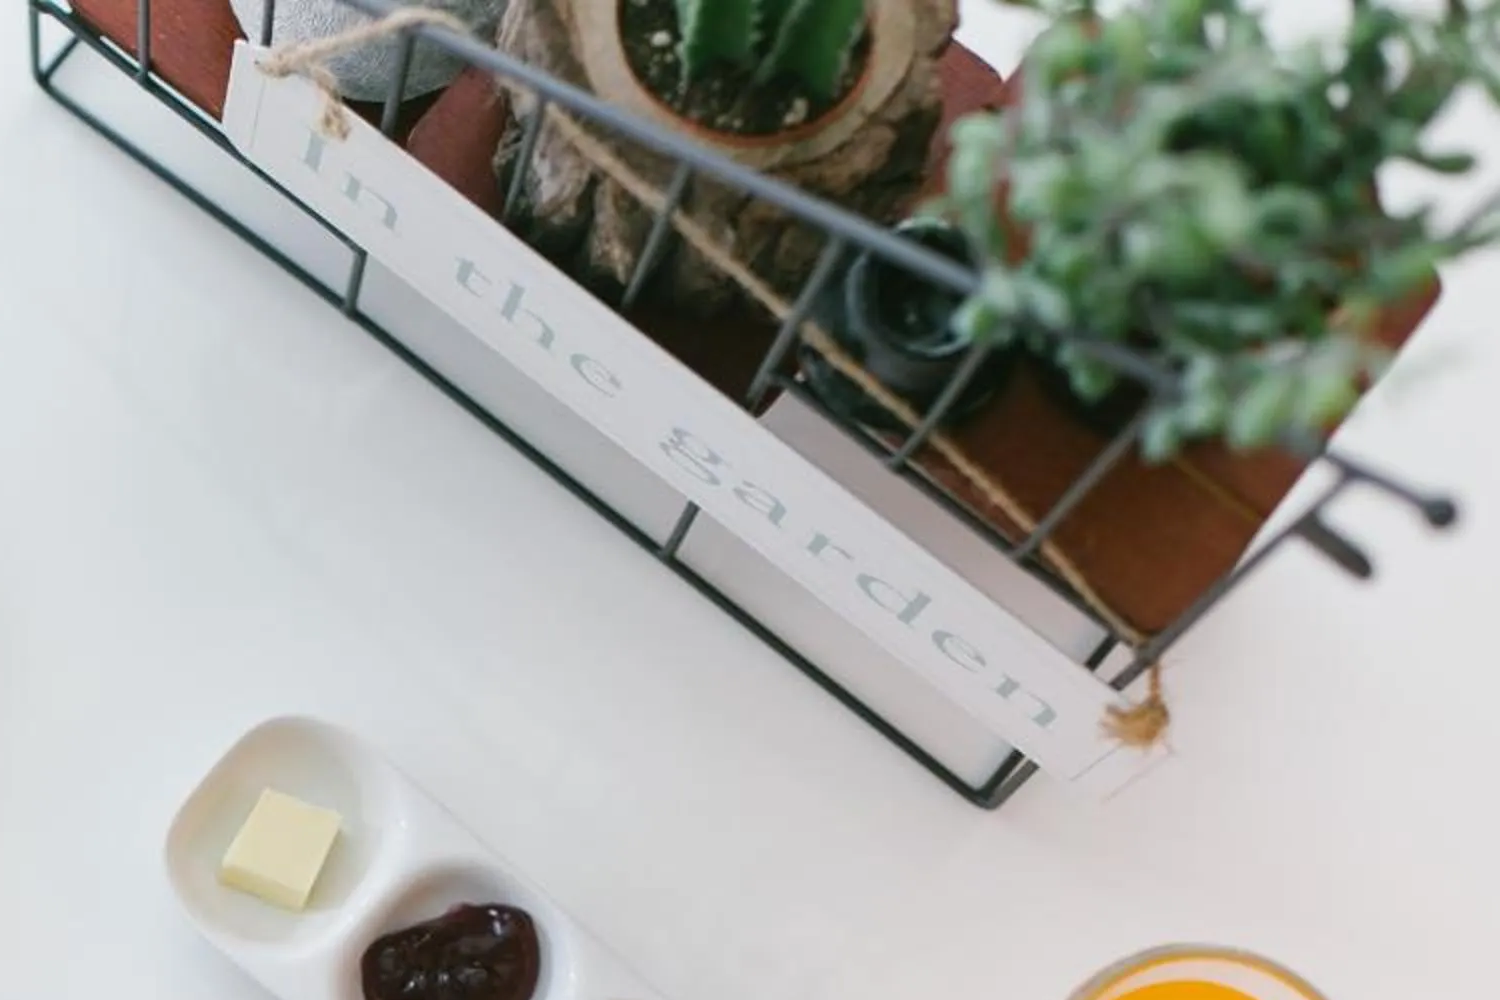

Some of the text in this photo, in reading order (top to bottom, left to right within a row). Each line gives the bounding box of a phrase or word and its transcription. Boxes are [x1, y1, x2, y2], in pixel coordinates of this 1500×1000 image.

[301, 128, 1058, 729] In the garden
